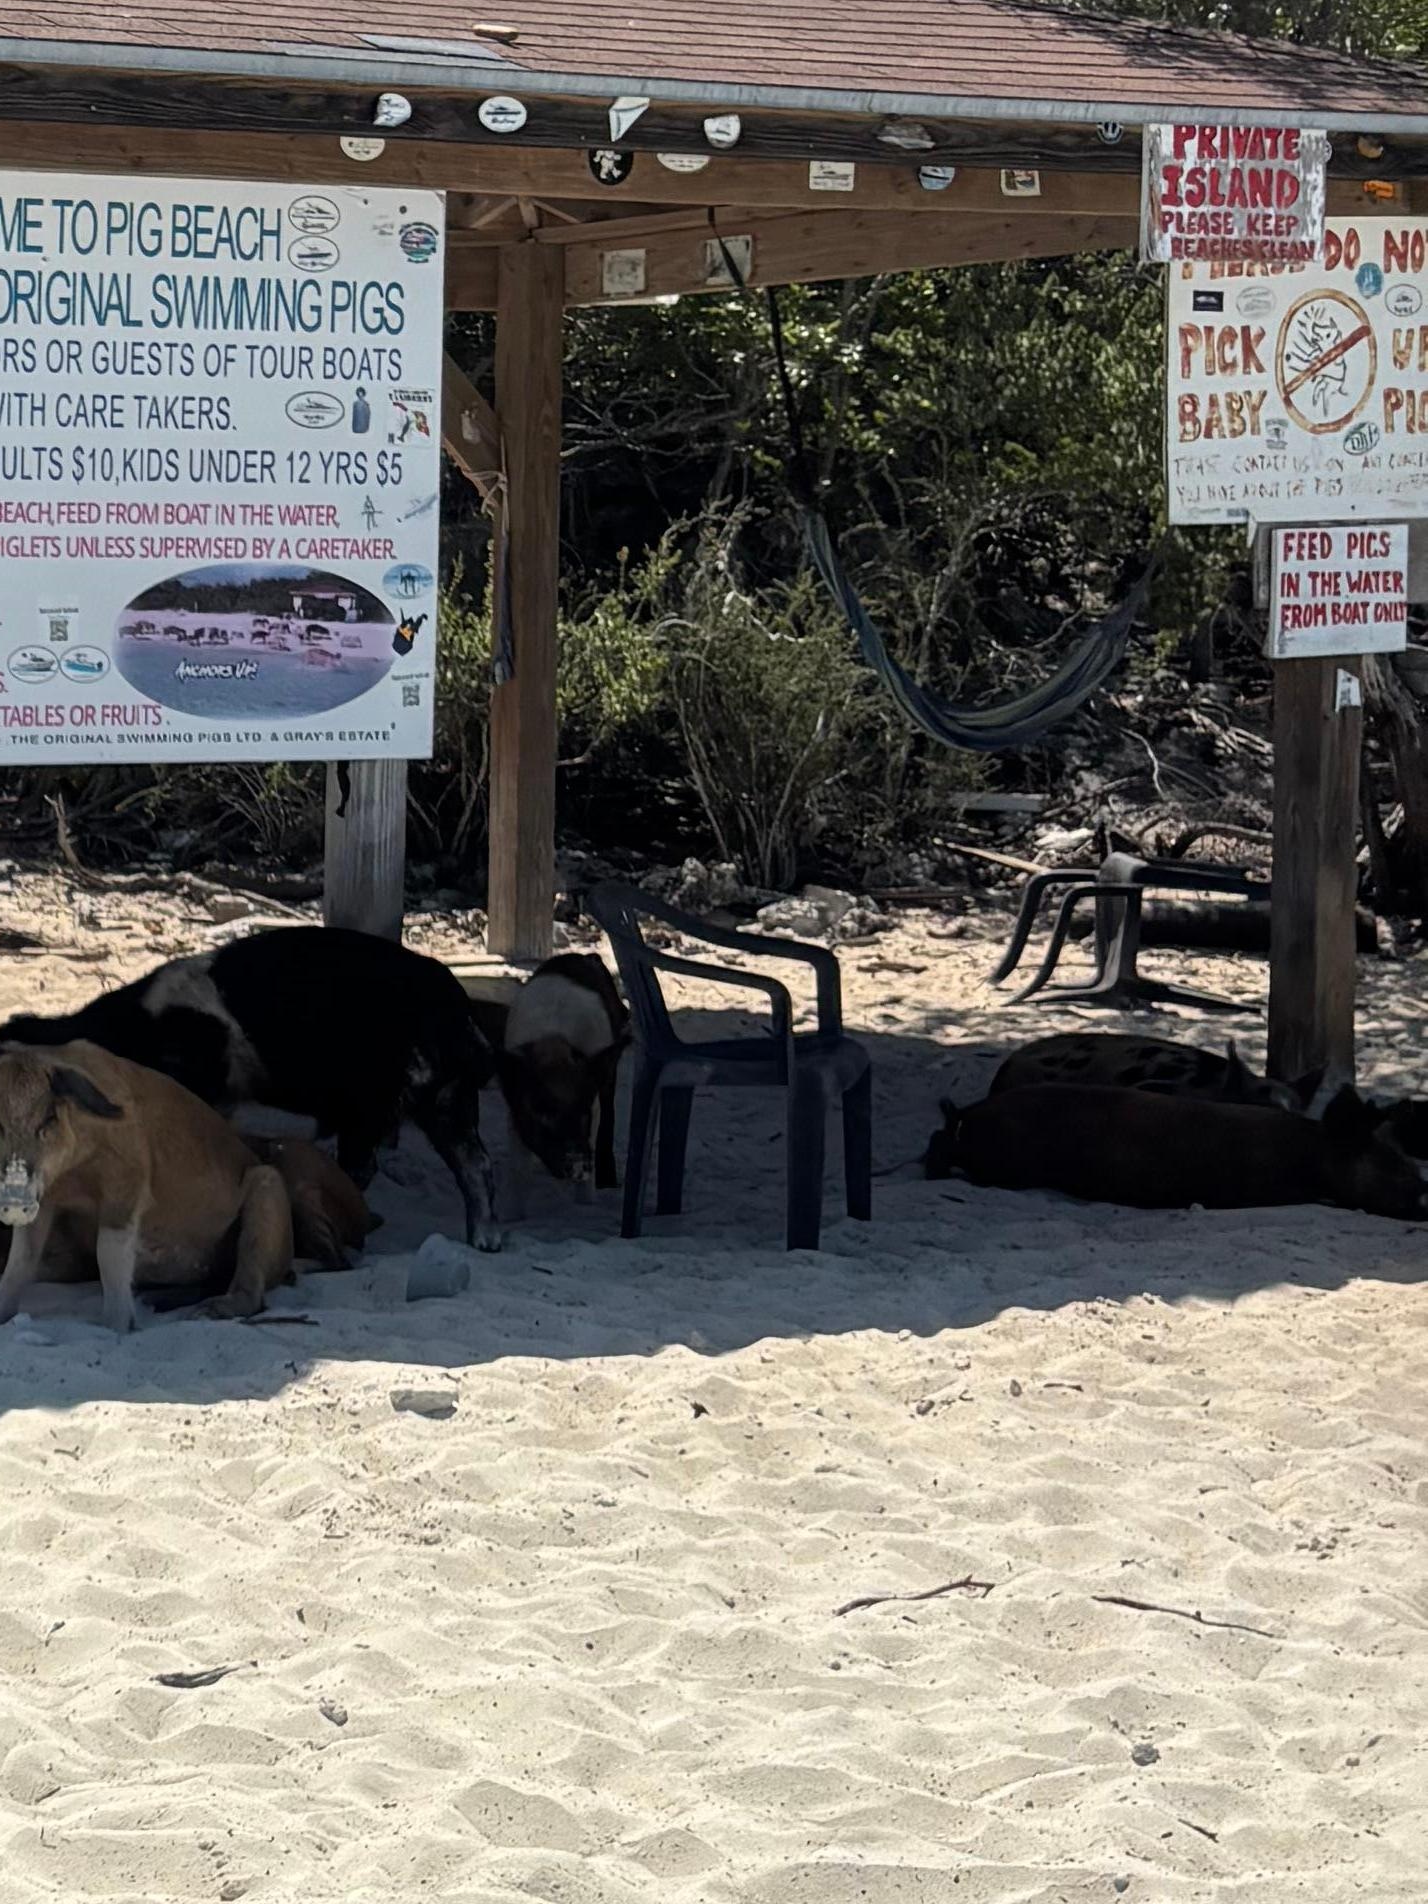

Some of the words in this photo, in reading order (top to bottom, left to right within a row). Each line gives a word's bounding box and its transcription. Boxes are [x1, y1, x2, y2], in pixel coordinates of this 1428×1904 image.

[1172, 125, 1301, 160] PRIVATE
[1161, 165, 1300, 209] ISLAND
[52, 199, 96, 255] TO
[106, 201, 162, 258] PIG
[171, 204, 281, 261] BEACH
[1160, 211, 1234, 235] PLEASE
[1246, 213, 1299, 236] KEEP
[1255, 240, 1316, 262] CLEAN
[1325, 228, 1360, 271] DO
[1384, 229, 1428, 273] NO
[150, 273, 322, 332] SWIMMING
[331, 280, 404, 335] PIGS
[46, 340, 83, 374] OR
[92, 341, 194, 376] GUESTS
[203, 345, 237, 377] OF
[245, 345, 314, 380] TOUR
[323, 347, 402, 382] BOATS
[1179, 323, 1266, 379] PICK
[55, 393, 124, 429] CARE
[133, 395, 237, 431] TAKERS.
[1178, 390, 1267, 442] BABY
[189, 449, 276, 484] UNDER
[286, 450, 311, 484] 12
[319, 450, 368, 485] YRS
[376, 449, 402, 488] $5
[106, 502, 159, 526] FROM
[164, 503, 211, 526] BOAT
[216, 504, 235, 526] IN
[239, 504, 275, 526] THE
[66, 537, 135, 558] UNLESS
[139, 537, 244, 559] SUPERVISED
[252, 537, 275, 559] BY
[278, 538, 292, 559] A
[1283, 532, 1332, 562] FEED
[1347, 532, 1390, 559] PIGS
[1281, 572, 1300, 598] IN
[1308, 571, 1341, 597] THE
[1346, 570, 1404, 594] WATER
[1281, 604, 1327, 629] FROM
[1331, 602, 1369, 626] BOAT
[70, 705, 95, 727] OR
[44, 734, 112, 744] ORIGINAL
[117, 733, 193, 744] SWIMMING
[338, 730, 390, 741] ESTATE
